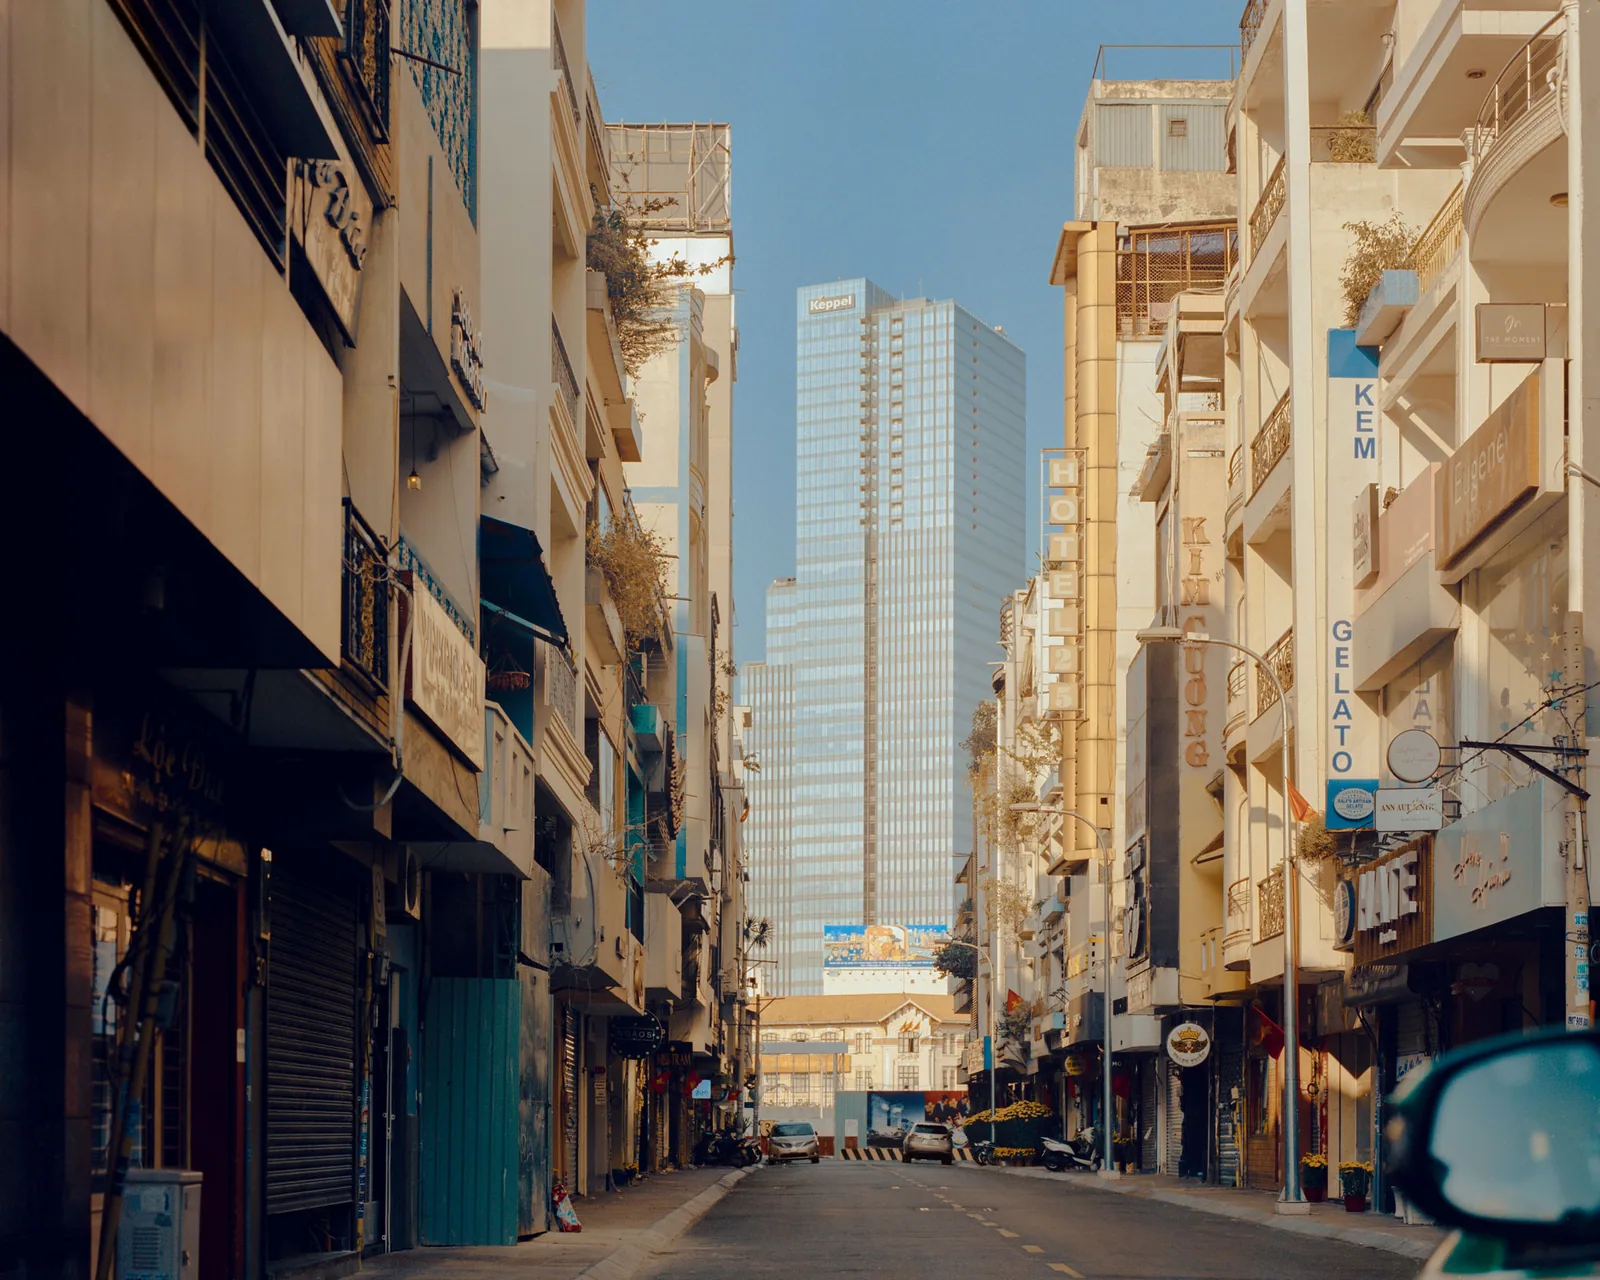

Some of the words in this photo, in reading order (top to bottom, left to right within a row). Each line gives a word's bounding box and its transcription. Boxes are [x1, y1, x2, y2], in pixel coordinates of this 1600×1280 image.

[810, 295, 852, 311] Keppel
[1504, 336, 1541, 344] MOMENT
[1354, 383, 1376, 460] KEM
[1051, 462, 1076, 633] HOTEL
[1181, 516, 1211, 606] KIM
[1054, 648, 1073, 708] 25
[1332, 620, 1354, 773] GELATO
[1380, 804, 1396, 812] ANN
